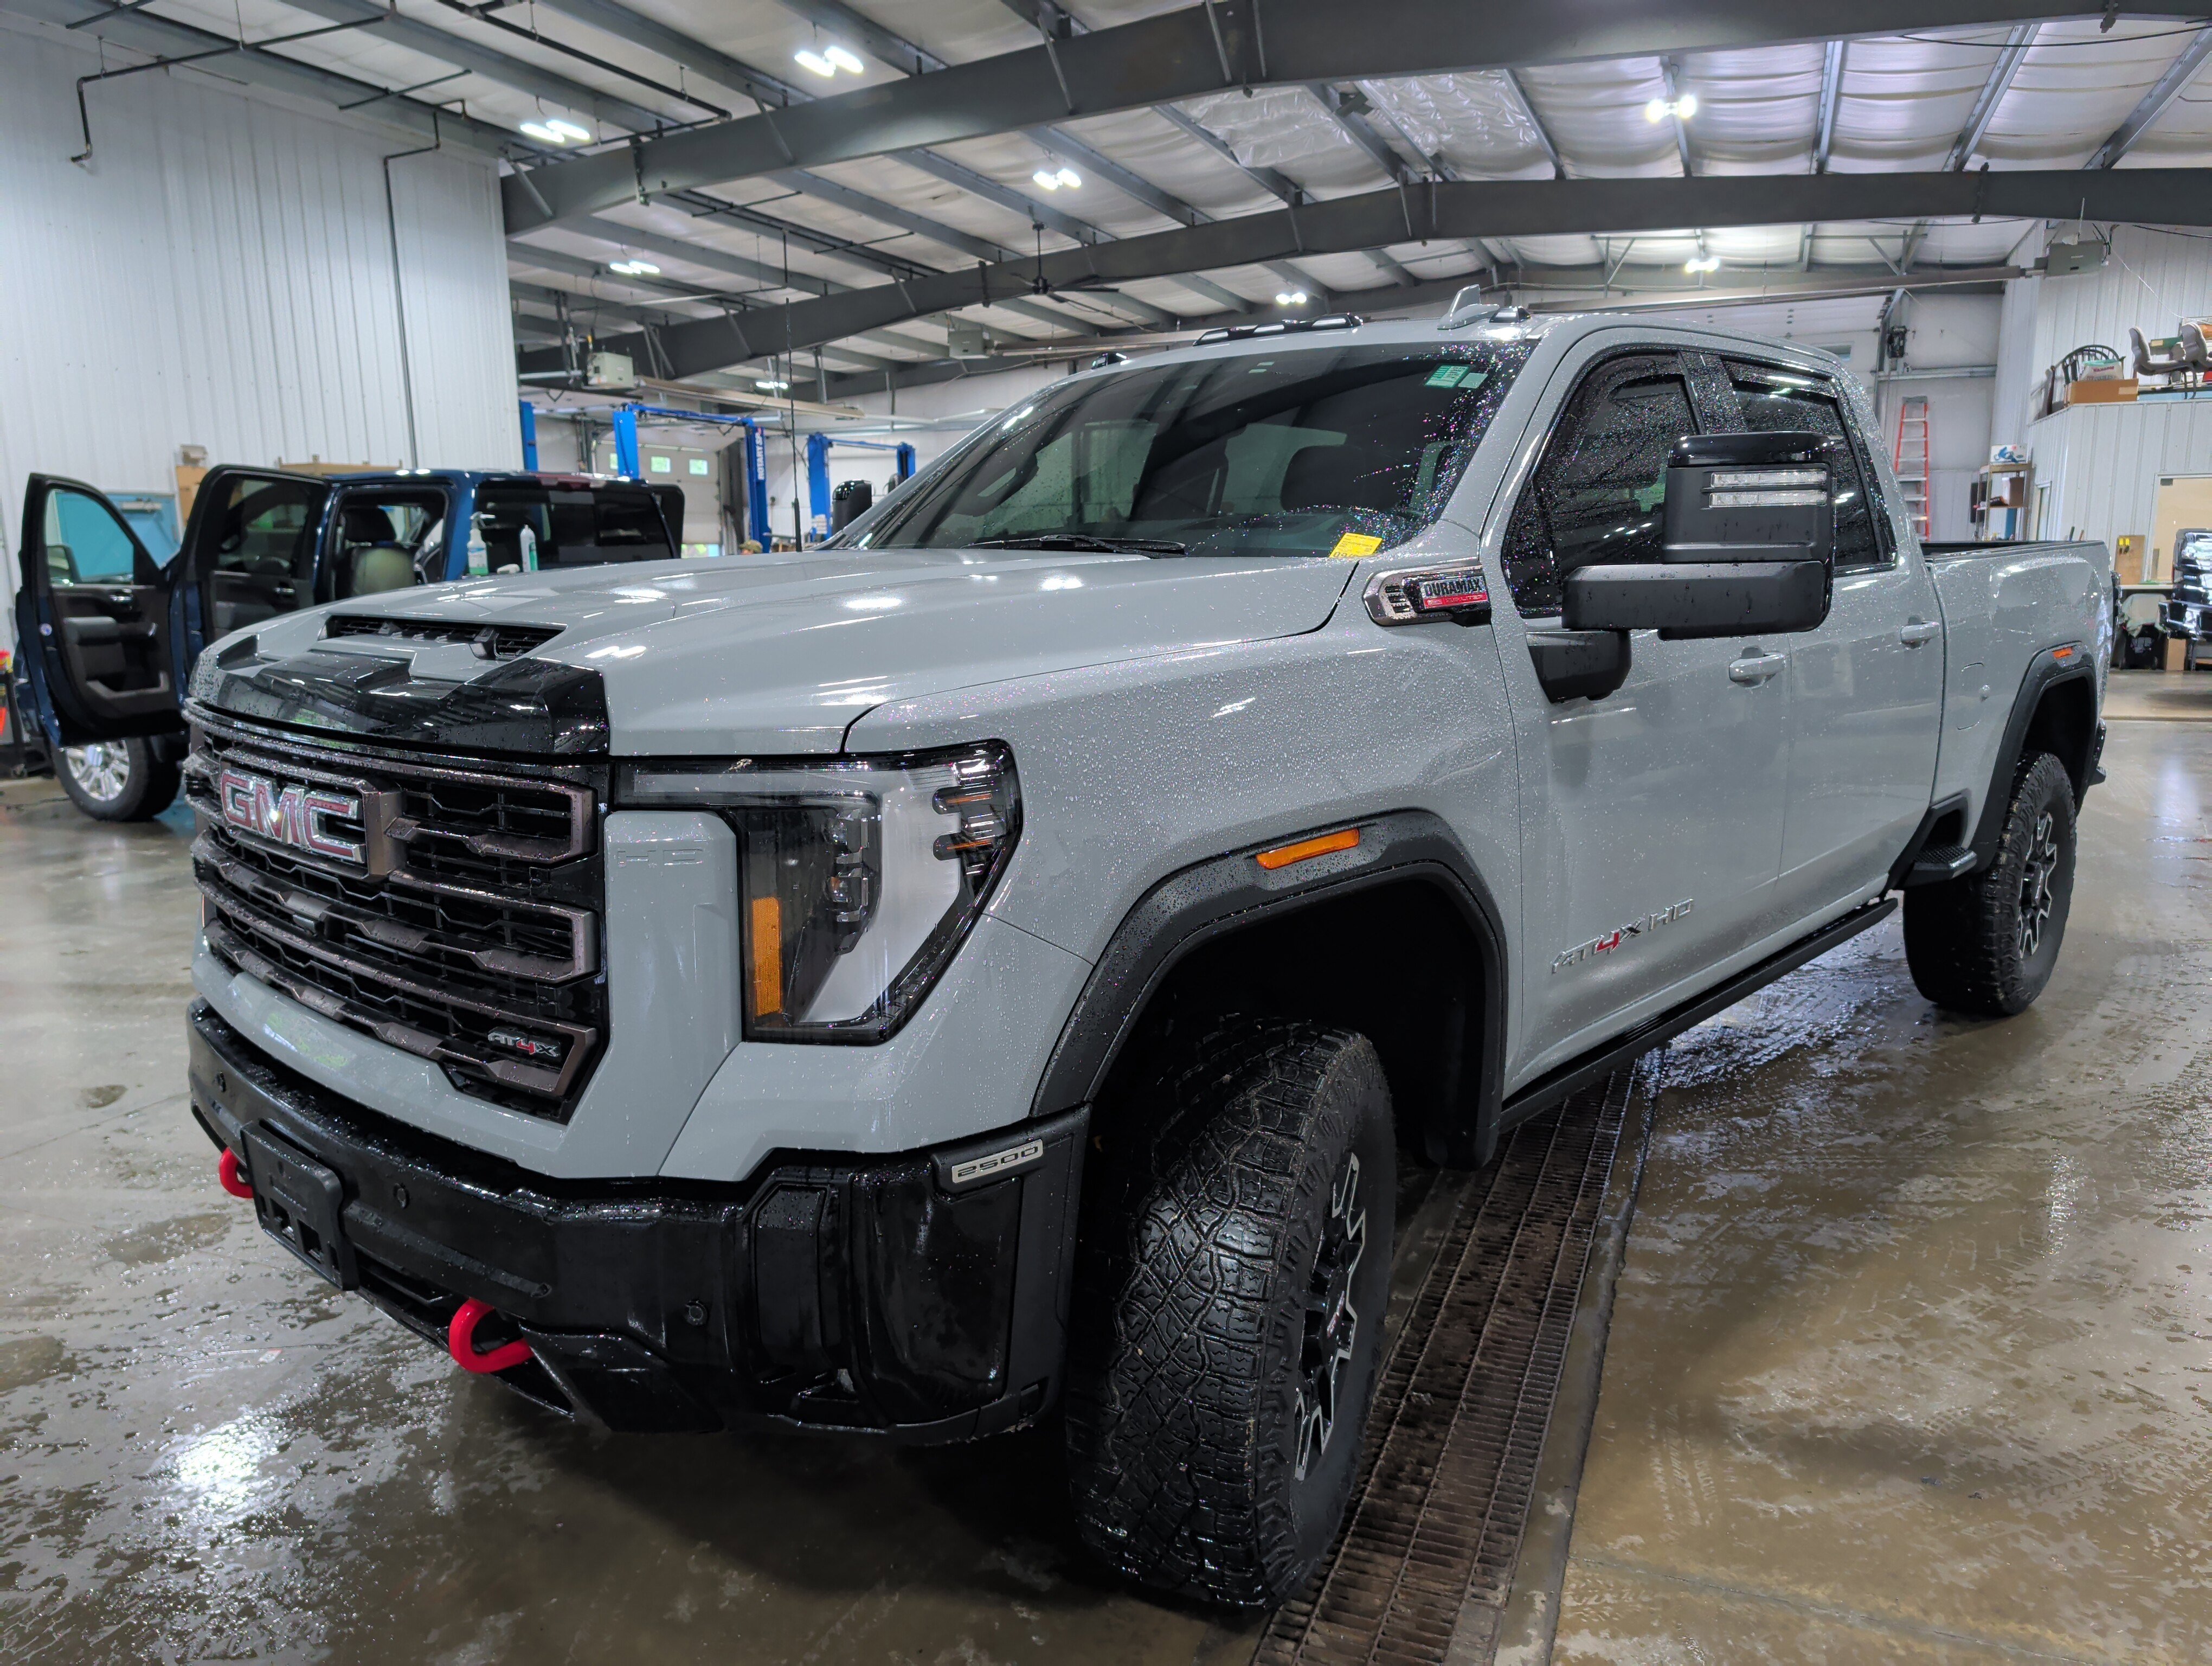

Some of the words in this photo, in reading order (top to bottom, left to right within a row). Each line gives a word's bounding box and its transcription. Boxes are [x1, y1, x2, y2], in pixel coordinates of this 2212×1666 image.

[1423, 576, 1486, 597] DURAMAX
[221, 770, 364, 863] GMC
[1551, 917, 1646, 974] AT4X
[1647, 898, 1694, 932] HD
[487, 1031, 560, 1058] AT4X
[957, 1145, 1038, 1177] 2500
